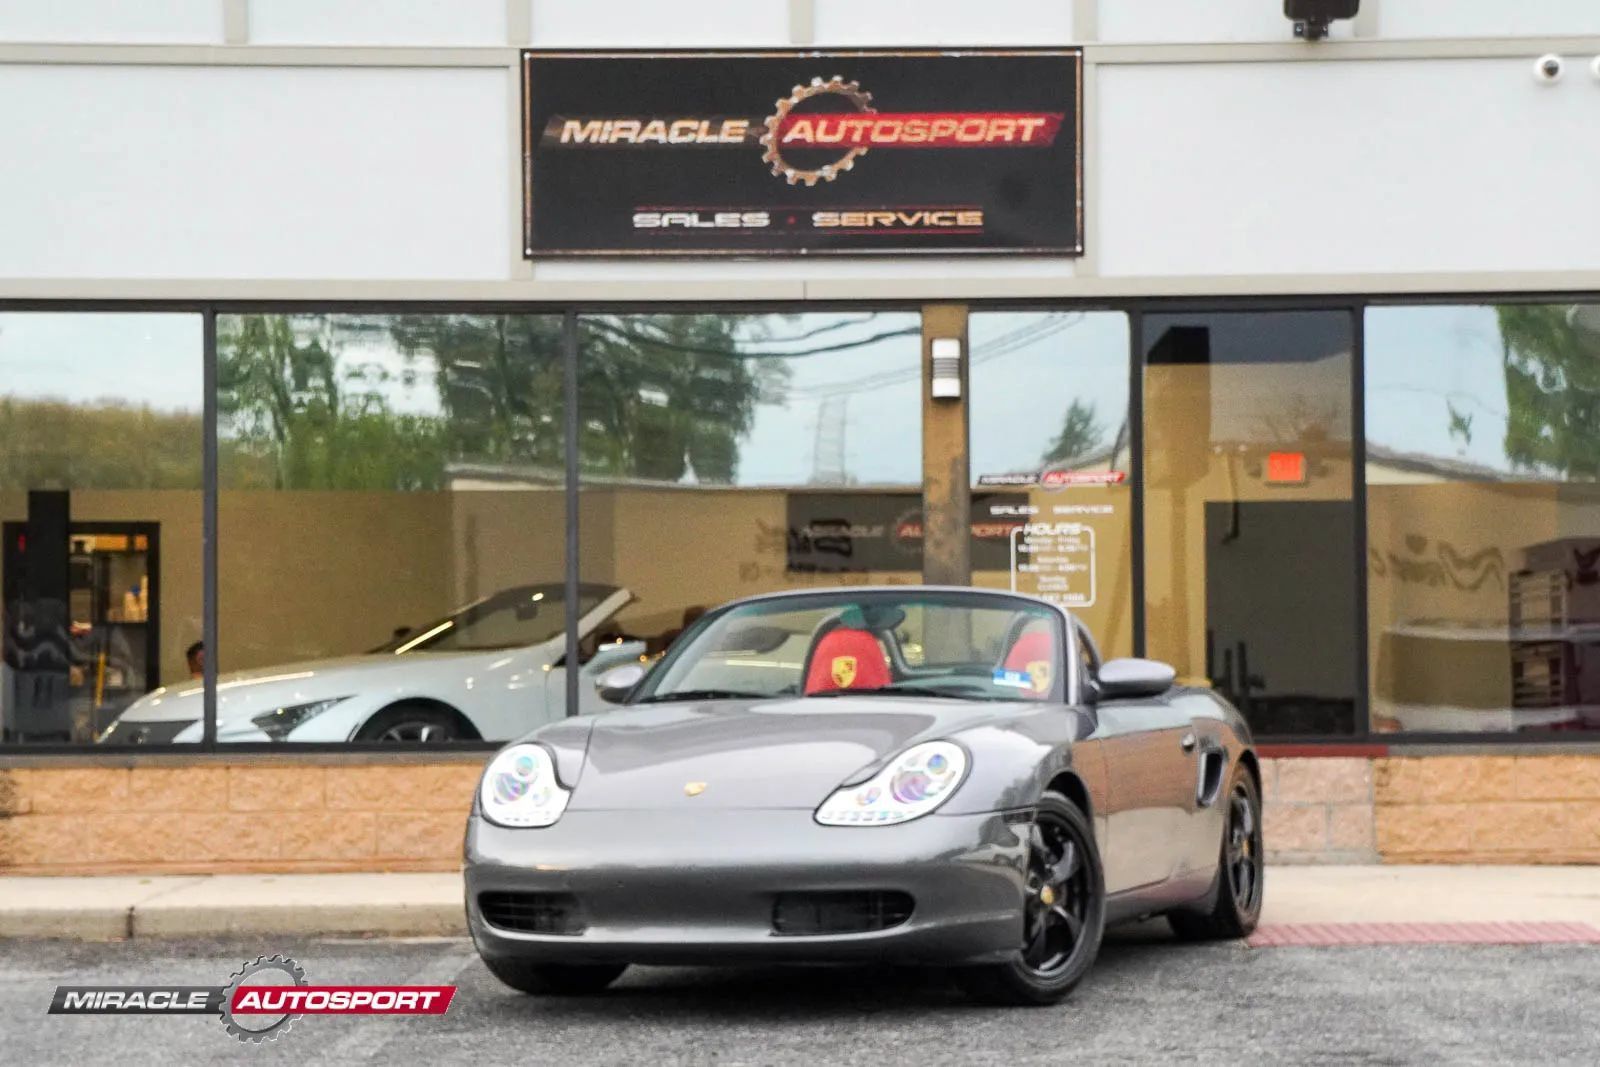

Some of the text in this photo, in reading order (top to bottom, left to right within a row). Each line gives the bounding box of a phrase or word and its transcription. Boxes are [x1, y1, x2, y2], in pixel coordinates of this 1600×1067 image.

[560, 118, 1046, 144] MIRACLE AUTOSPORT
[632, 211, 984, 228] SALES SERVICE
